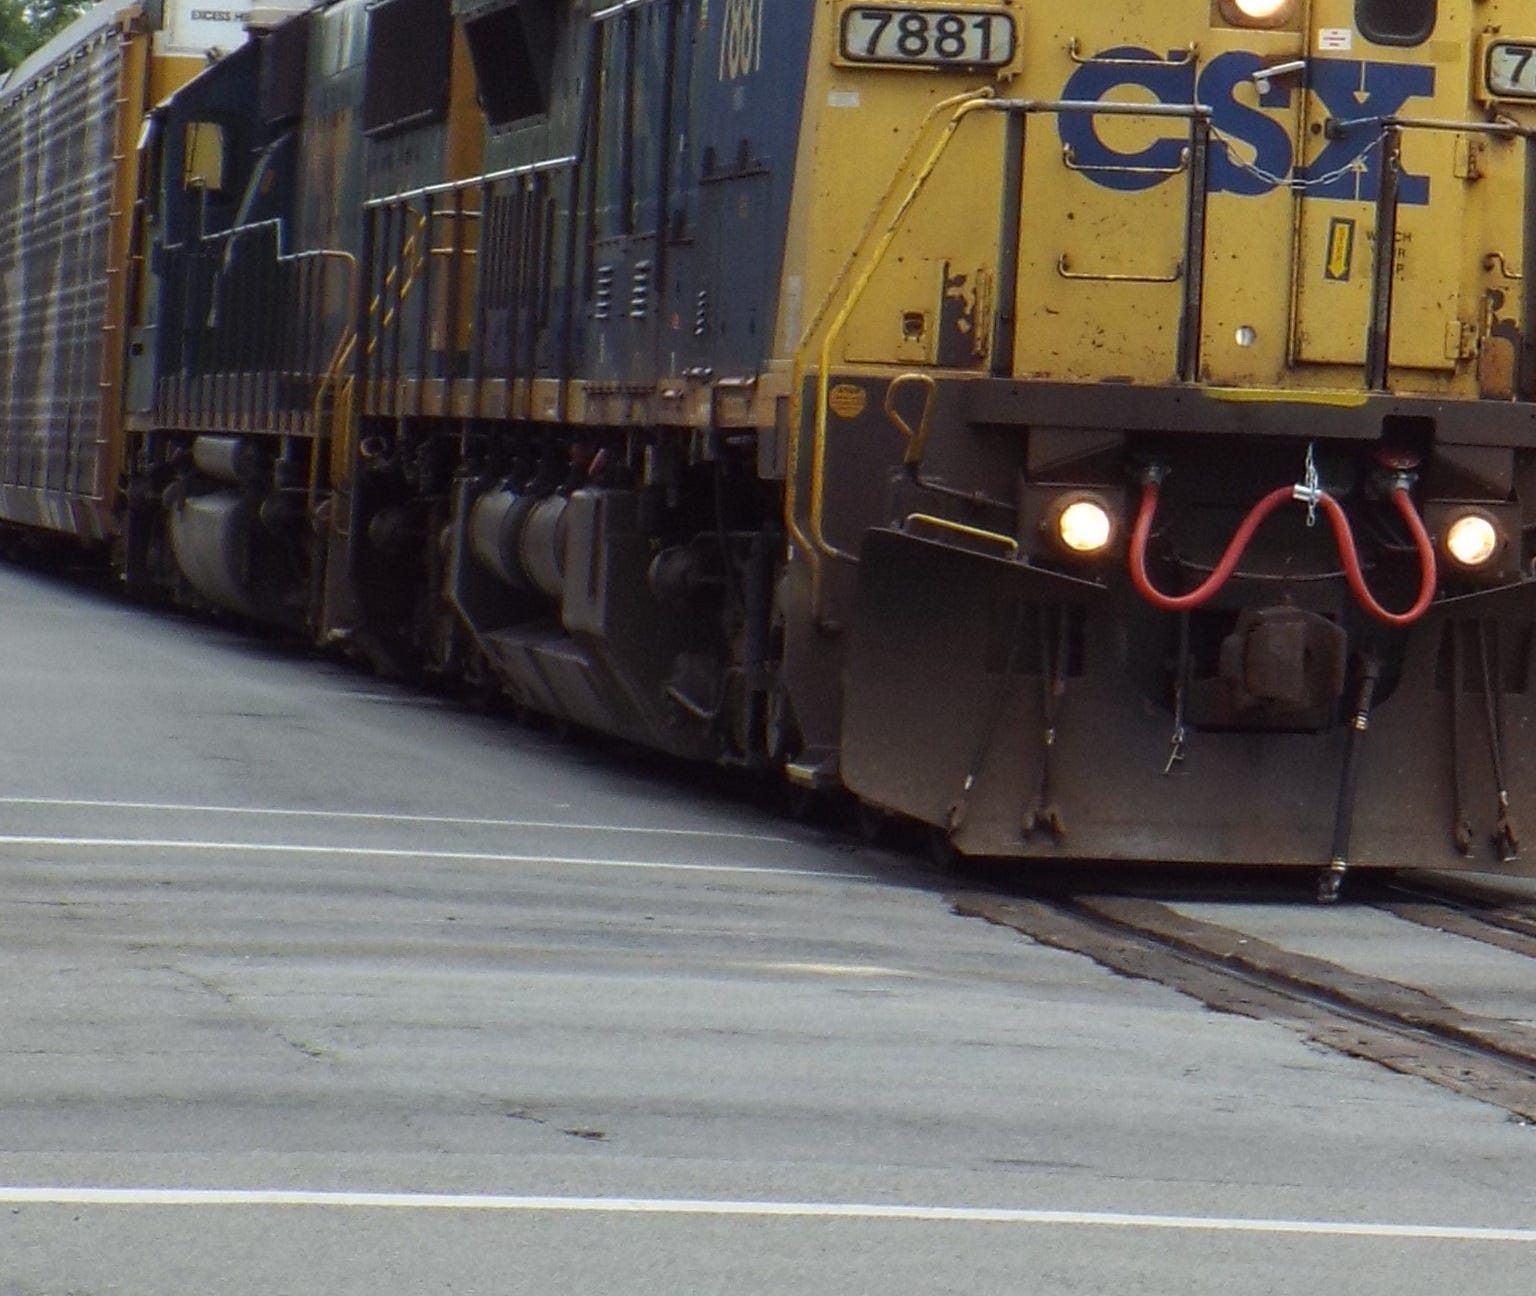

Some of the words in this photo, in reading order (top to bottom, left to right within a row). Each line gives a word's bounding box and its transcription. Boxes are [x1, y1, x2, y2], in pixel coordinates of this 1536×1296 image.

[861, 12, 991, 60] 7881
[1057, 45, 1436, 206] CSX
[1366, 230, 1412, 243] WCH
